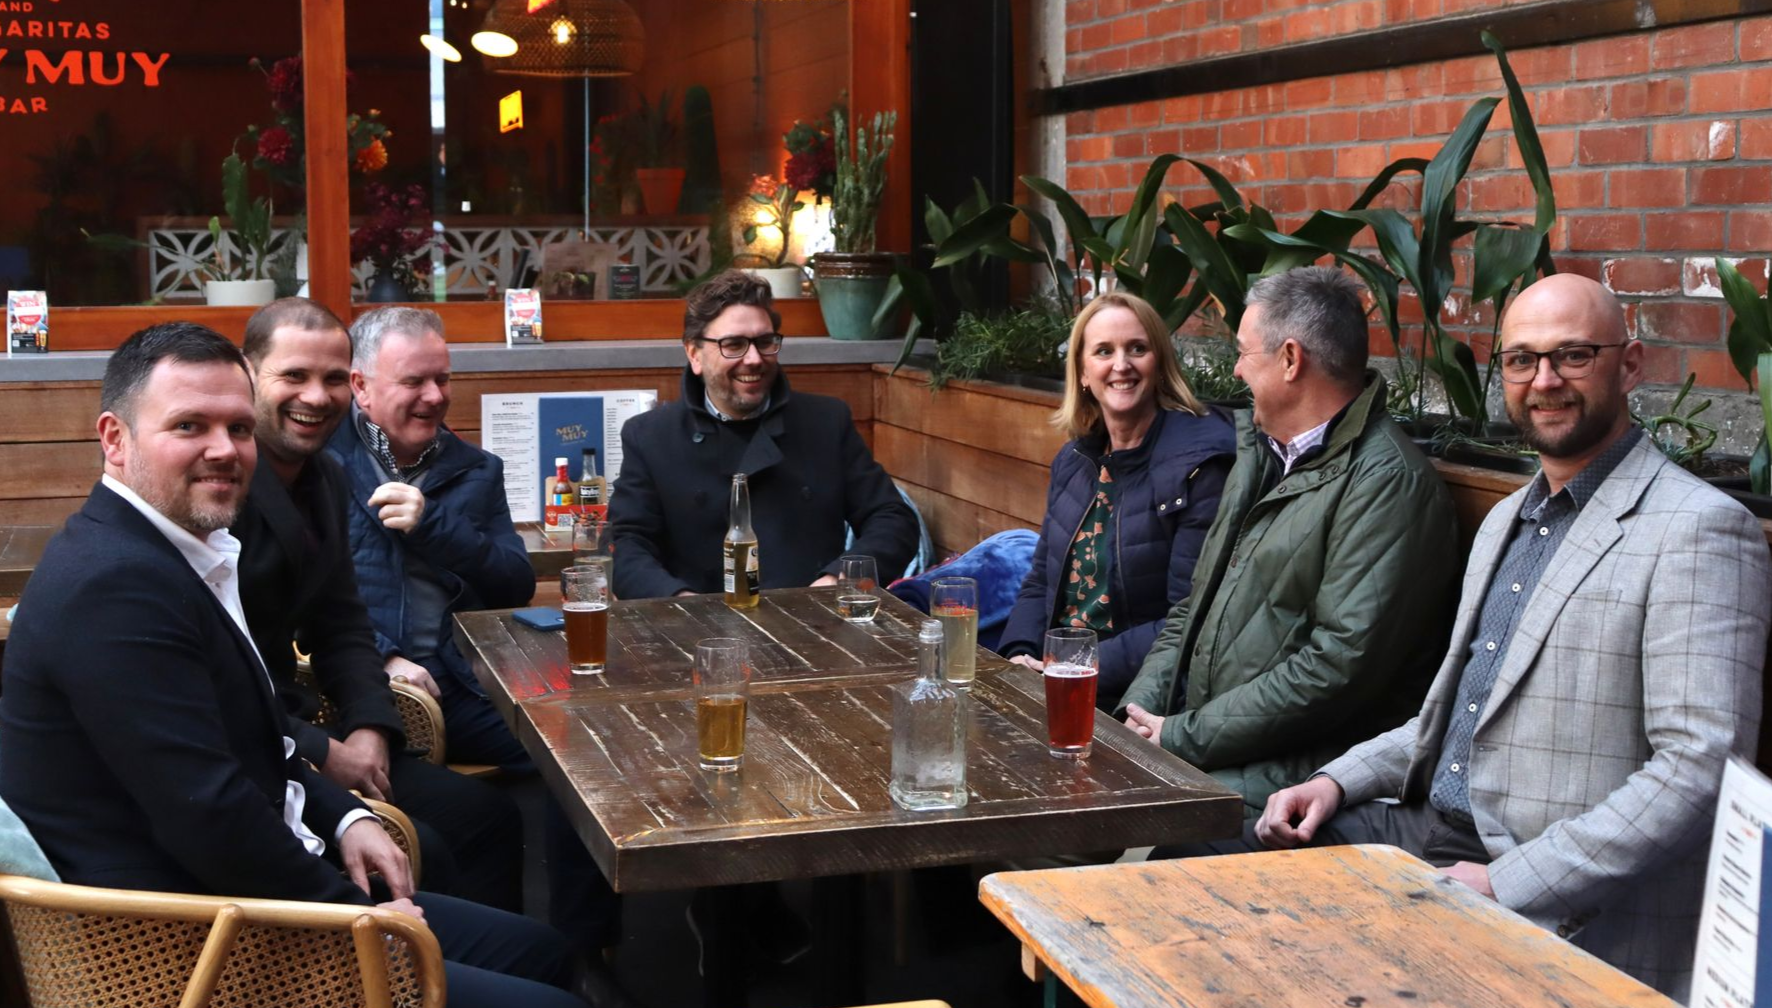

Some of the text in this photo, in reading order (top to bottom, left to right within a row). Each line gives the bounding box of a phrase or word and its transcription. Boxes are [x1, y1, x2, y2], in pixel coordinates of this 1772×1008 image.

[0, 2, 33, 12] AND
[0, 20, 110, 39] ARITAS
[25, 49, 170, 87] MUY
[556, 424, 582, 436] MUY
[562, 430, 588, 443] MUY
